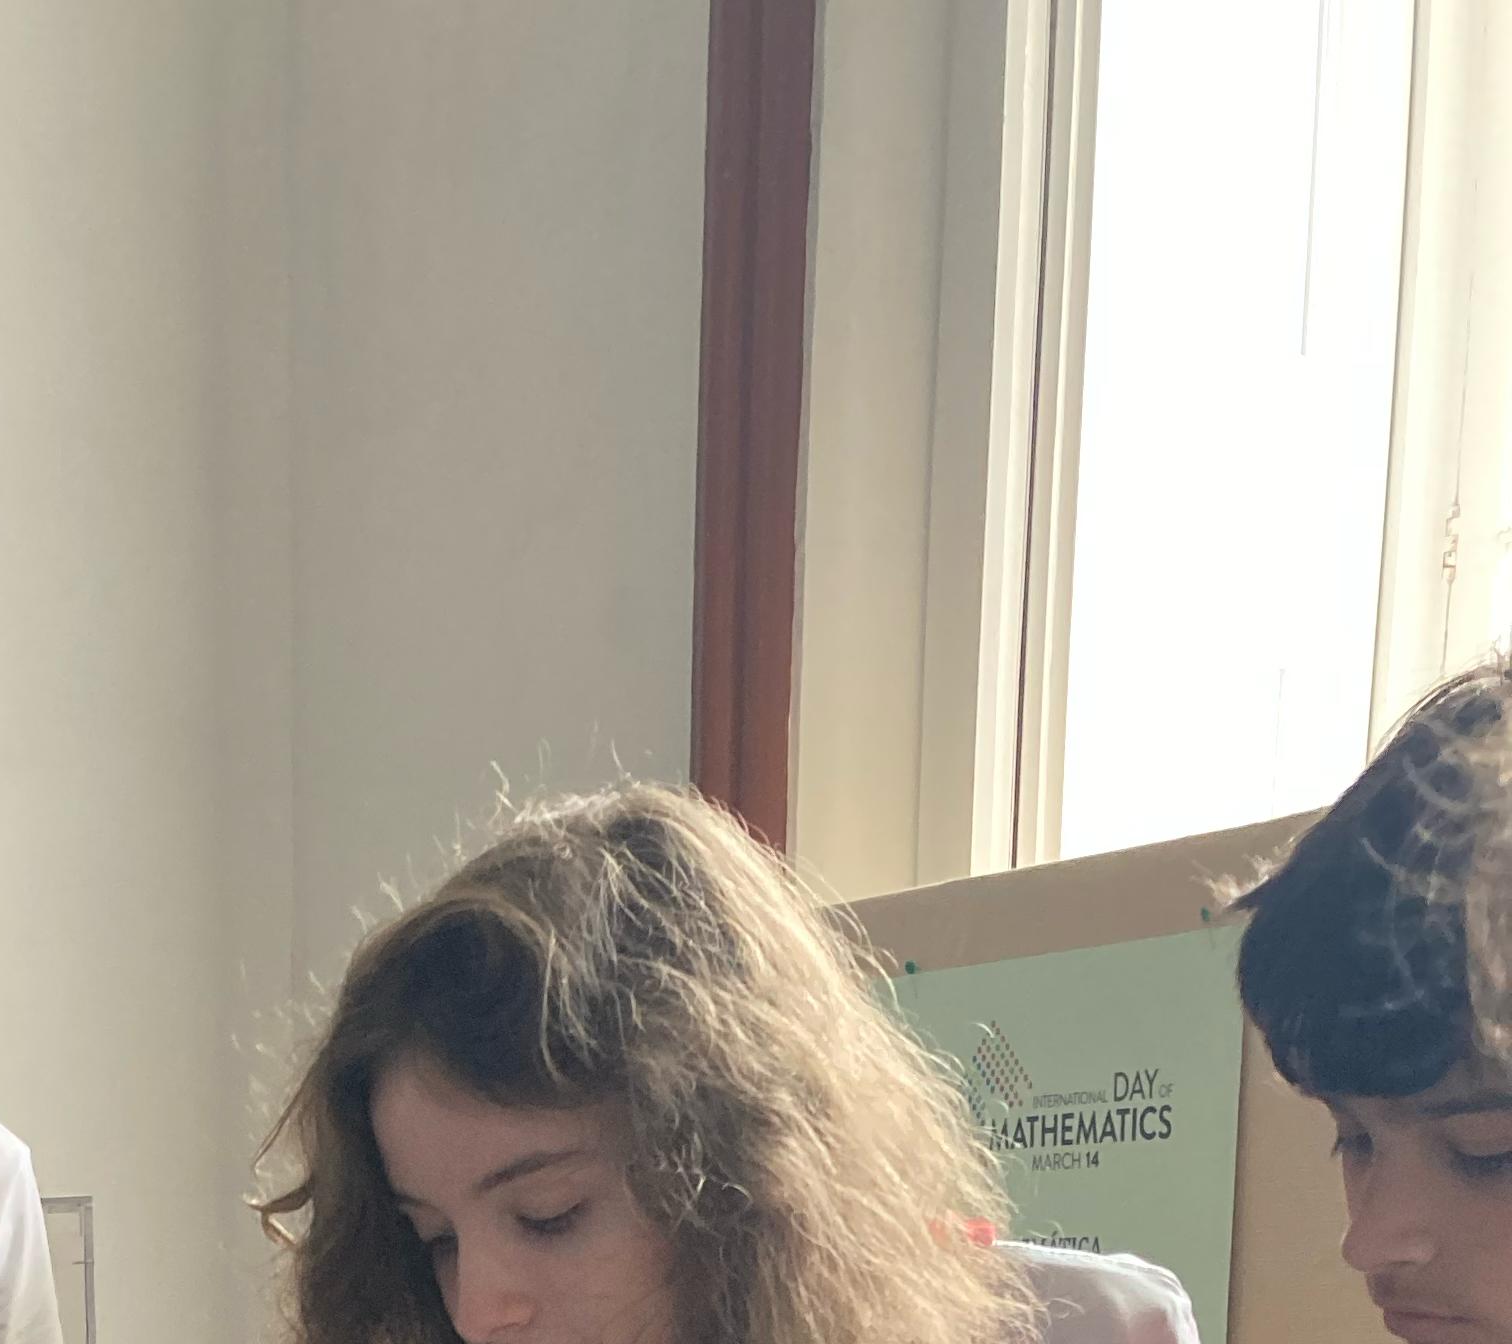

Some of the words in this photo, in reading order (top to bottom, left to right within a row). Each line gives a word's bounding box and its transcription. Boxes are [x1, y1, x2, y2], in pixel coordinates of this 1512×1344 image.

[1032, 1089, 1108, 1109] INTERNATIONAL
[1114, 1068, 1159, 1102] DAY
[1159, 1083, 1174, 1098] OF
[990, 1104, 1173, 1150] MATHEMATICS
[1032, 1152, 1081, 1171] MARCH
[1085, 1151, 1100, 1168] 14
